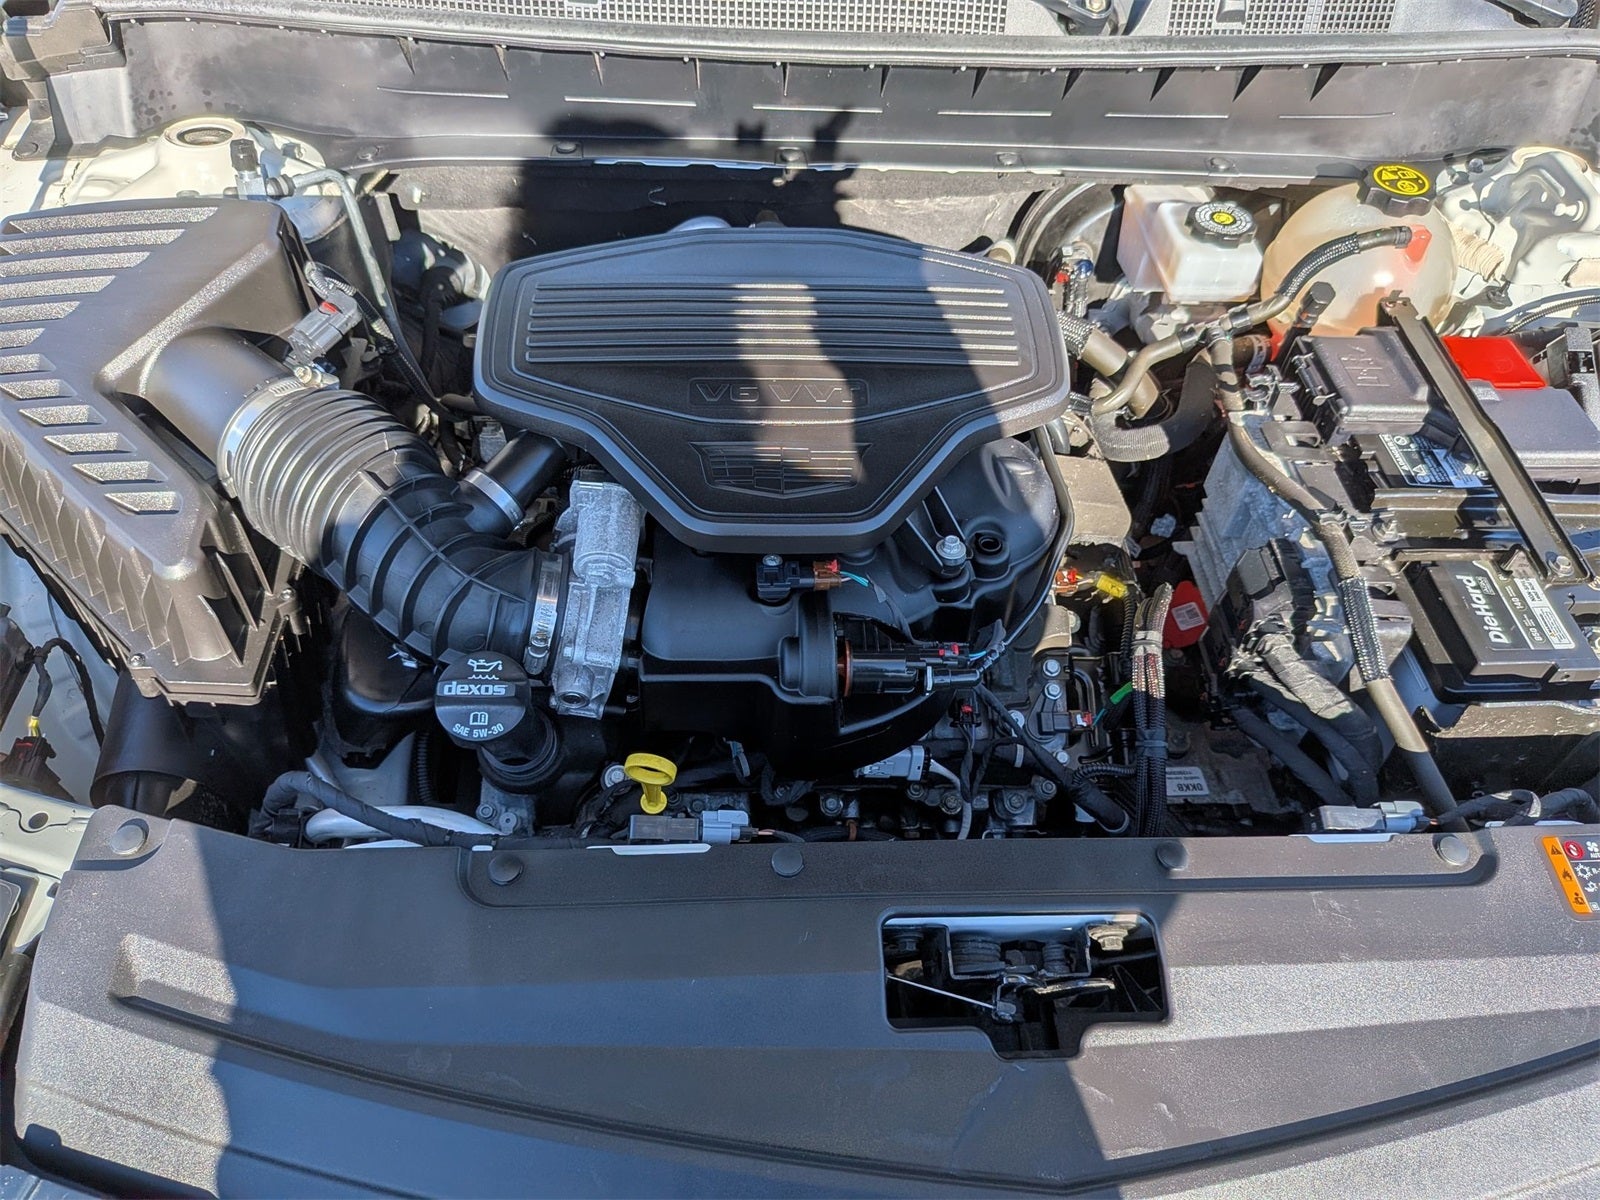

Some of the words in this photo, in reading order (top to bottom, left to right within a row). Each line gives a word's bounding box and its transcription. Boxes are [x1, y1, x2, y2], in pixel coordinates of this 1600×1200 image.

[696, 384, 759, 402] V6
[768, 384, 861, 403] VVT
[1455, 574, 1511, 644] DieHard
[443, 681, 509, 695] dexos
[452, 723, 471, 737] SAE
[473, 723, 504, 738] 5W-30
